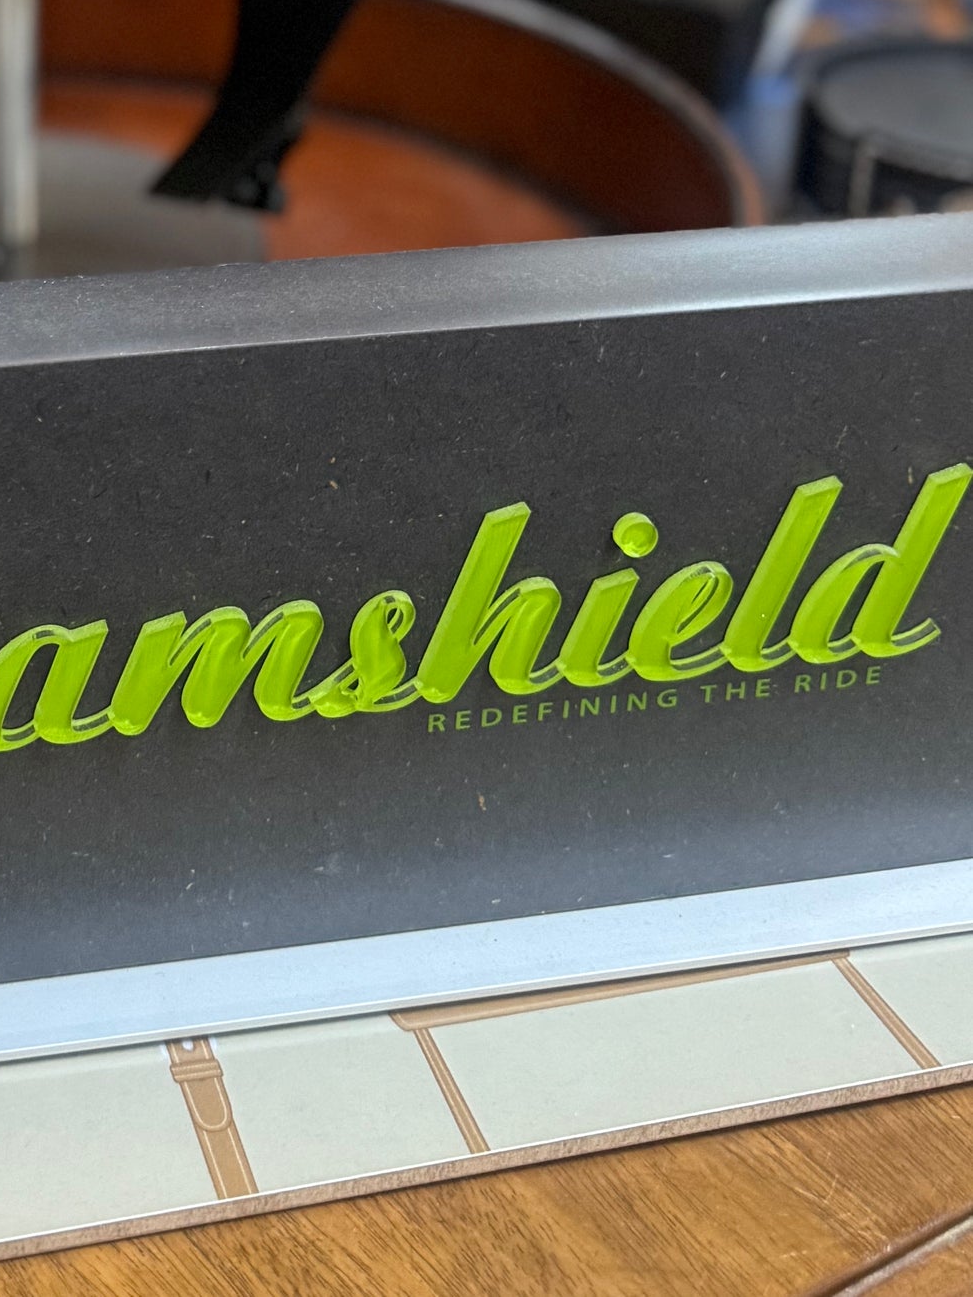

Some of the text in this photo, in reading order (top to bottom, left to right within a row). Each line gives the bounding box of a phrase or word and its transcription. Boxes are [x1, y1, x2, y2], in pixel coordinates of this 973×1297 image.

[428, 666, 881, 733] REDEFINING THE RIDE
